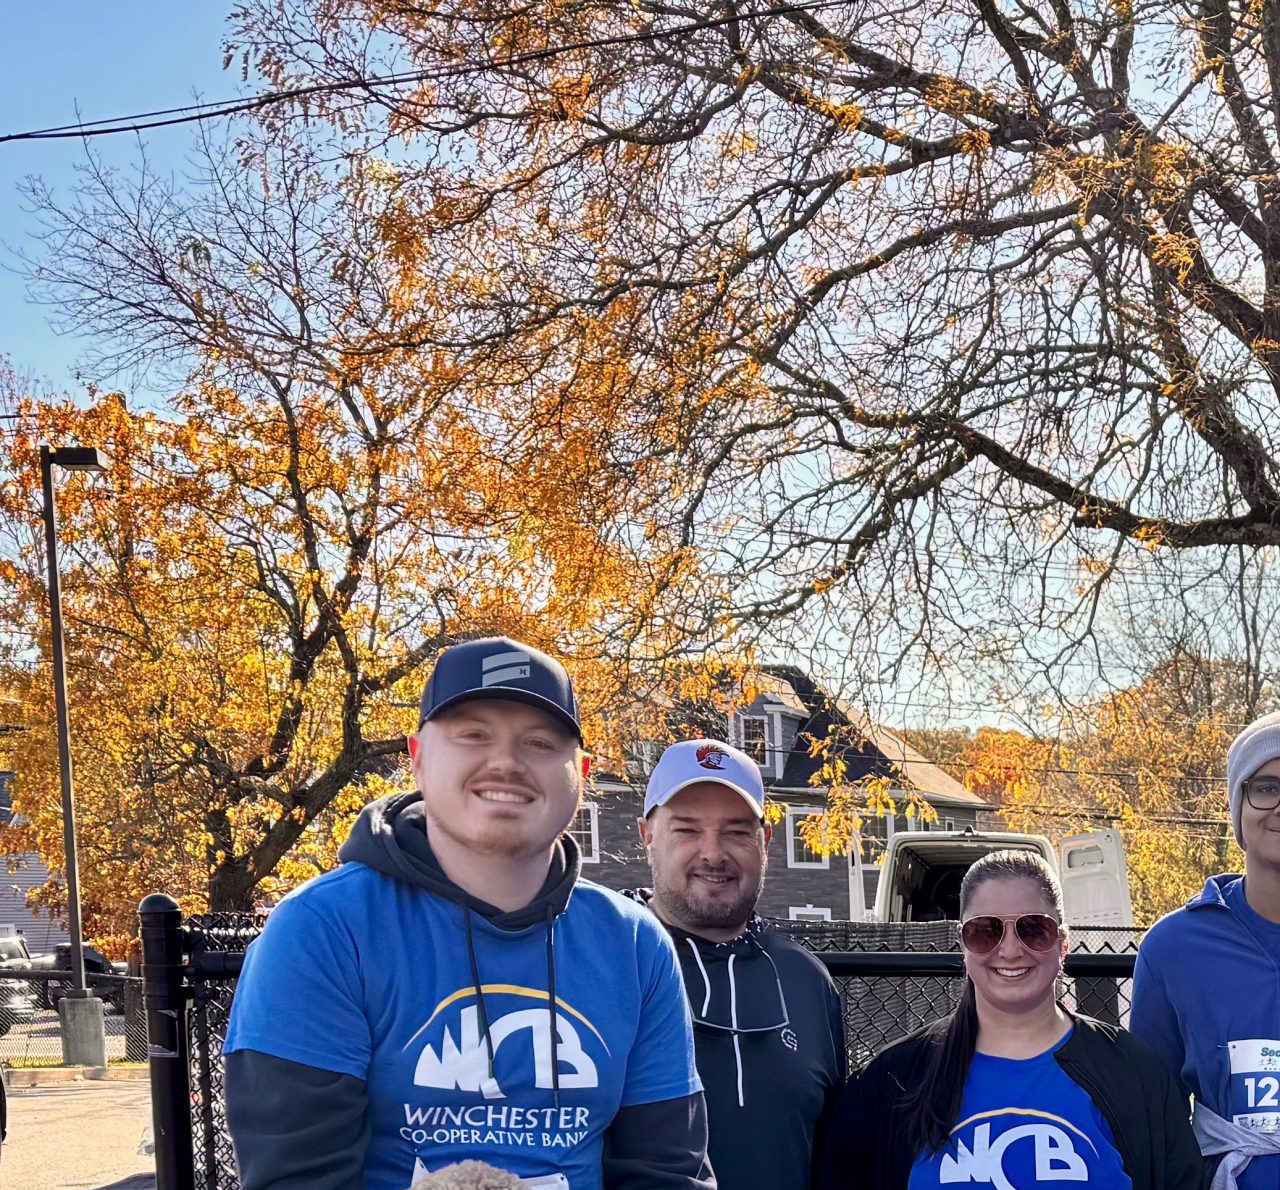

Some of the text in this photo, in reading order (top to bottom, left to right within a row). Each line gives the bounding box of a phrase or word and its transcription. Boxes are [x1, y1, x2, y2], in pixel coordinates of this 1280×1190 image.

[413, 1004, 598, 1100] WCB
[403, 1103, 590, 1129] WINCHESTER
[399, 1127, 589, 1148] CO-OPERATIVE BANK
